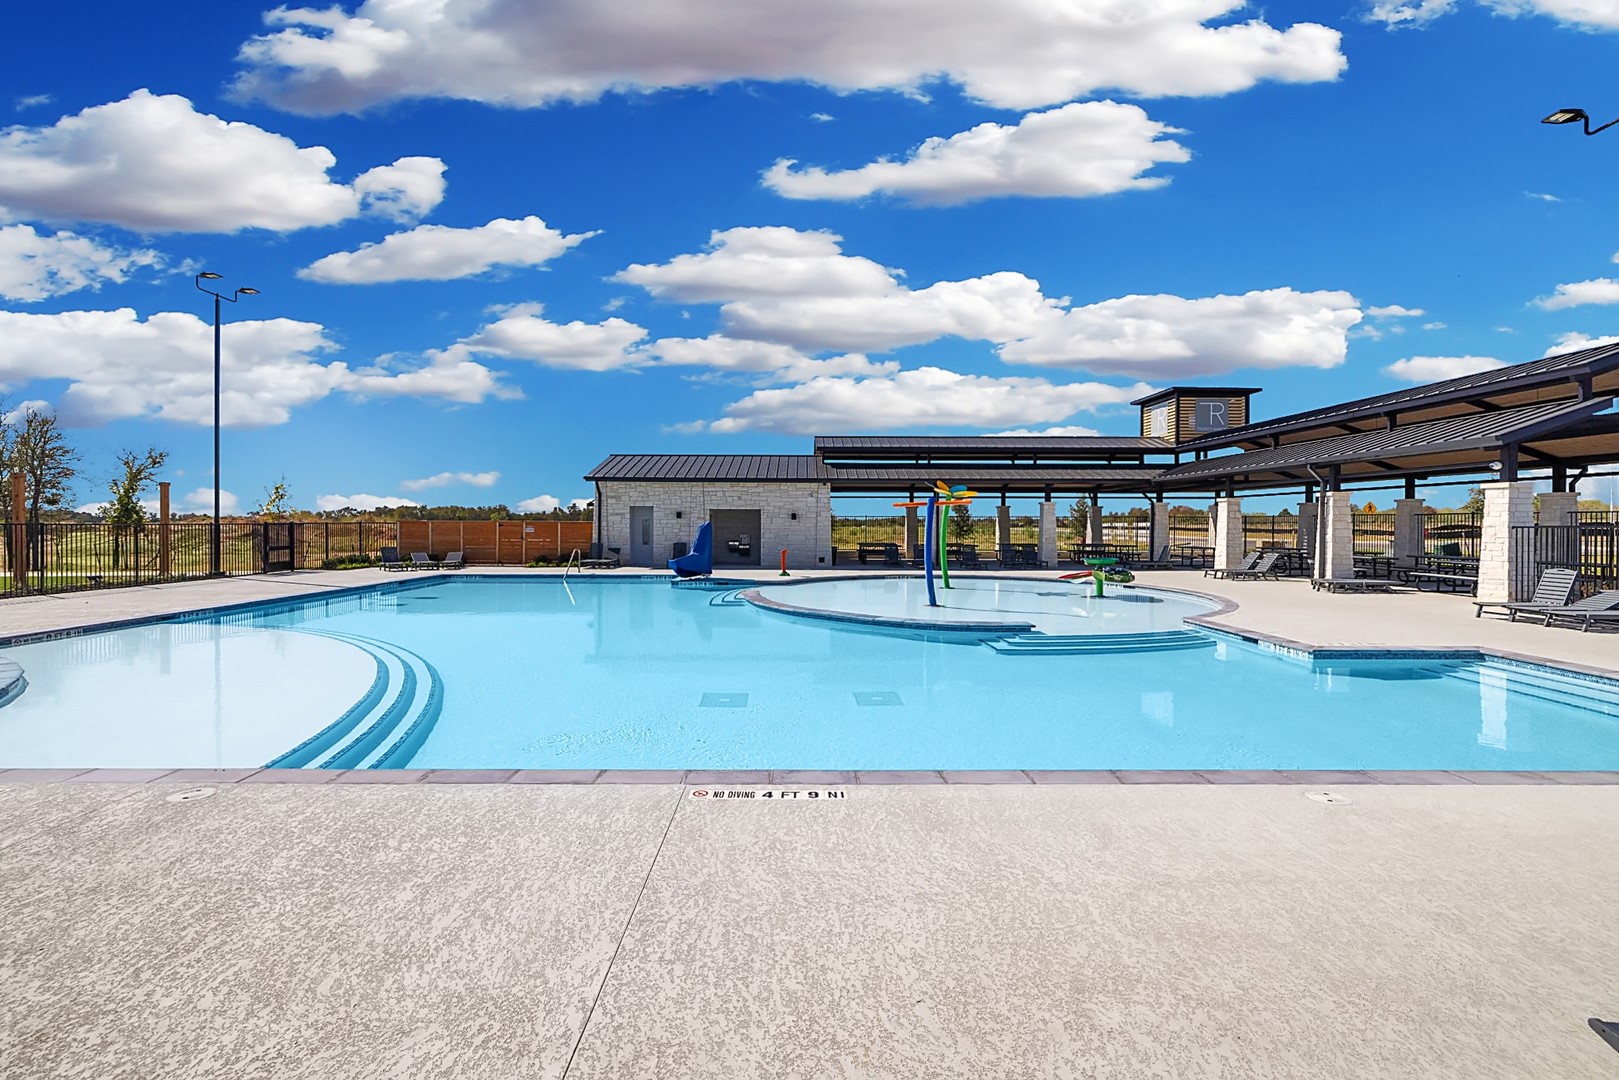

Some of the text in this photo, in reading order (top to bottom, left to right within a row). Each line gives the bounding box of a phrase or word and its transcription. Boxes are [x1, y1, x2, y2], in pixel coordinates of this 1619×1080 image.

[712, 790, 725, 799] NO
[727, 790, 756, 799] DIVING
[762, 790, 774, 799] 4
[781, 790, 800, 799] FT
[807, 791, 819, 799] 9
